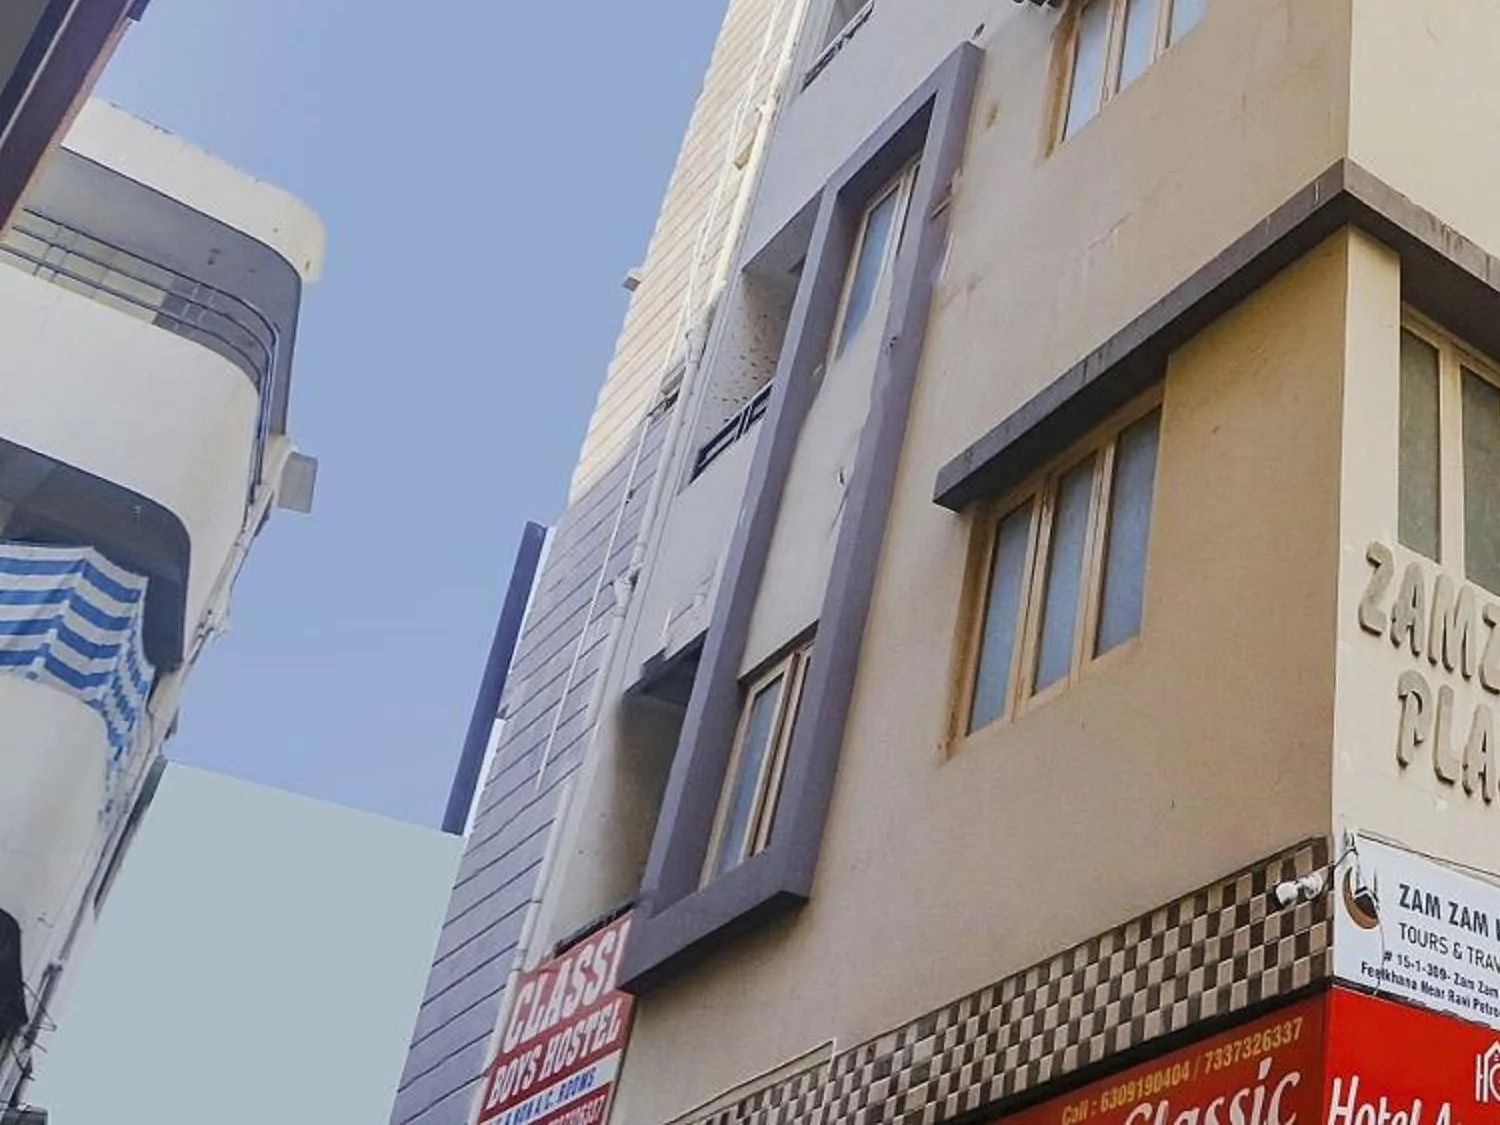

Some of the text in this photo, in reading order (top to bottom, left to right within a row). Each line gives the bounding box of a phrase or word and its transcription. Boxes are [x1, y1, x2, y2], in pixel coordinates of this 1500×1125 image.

[1399, 883, 1441, 920] ZAM
[1448, 900, 1489, 937] ZAM
[1399, 922, 1448, 955] TOURS
[1452, 942, 1463, 960] &
[486, 997, 623, 1109] BOYS HOSTEL
[1204, 1017, 1304, 1075] 7337326337
